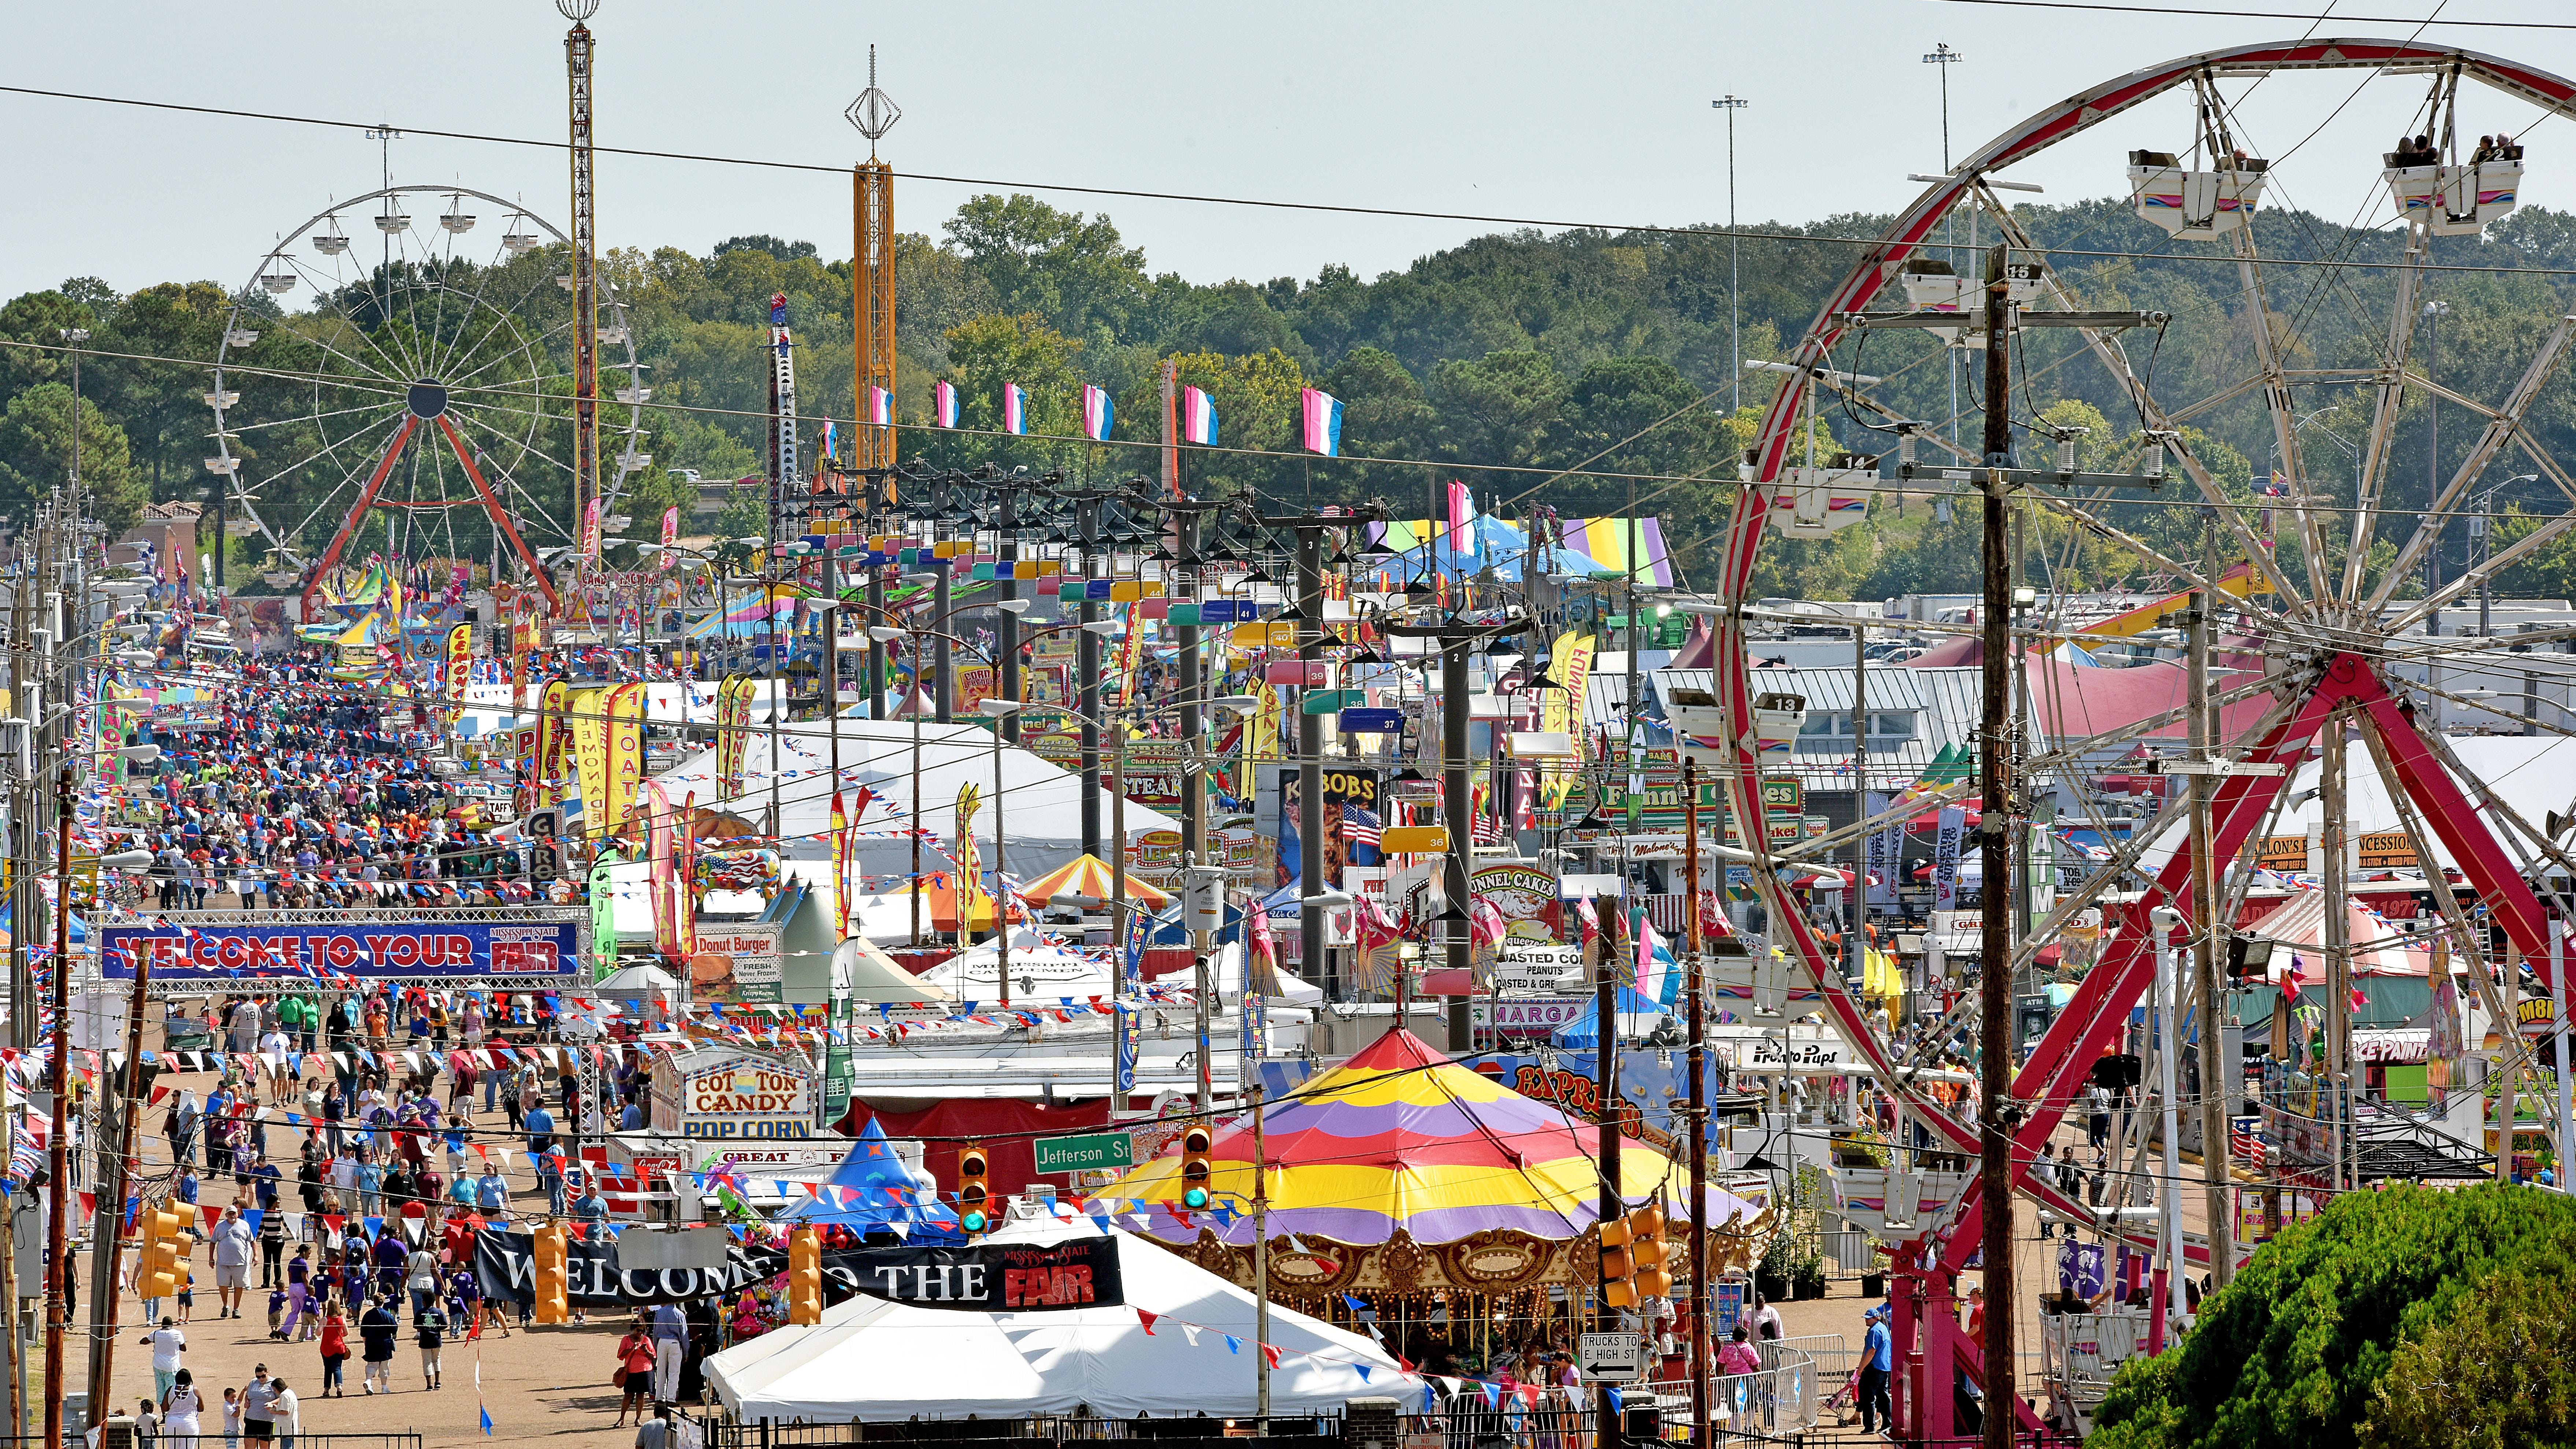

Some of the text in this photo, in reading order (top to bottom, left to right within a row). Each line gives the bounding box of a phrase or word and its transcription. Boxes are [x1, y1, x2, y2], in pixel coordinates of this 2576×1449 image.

[2494, 149, 2504, 161] 2
[2241, 159, 2247, 171] 1
[1845, 456, 1864, 468] 14
[1308, 541, 1313, 549] 3
[1454, 653, 1459, 662] 2
[1776, 699, 1795, 711] 13
[1024, 718, 1045, 728] nnel
[101, 686, 121, 785] LEMONAD
[1629, 723, 1647, 795] ATM
[1285, 773, 1375, 800] KBOBS
[1607, 784, 1702, 807] Fnnl
[489, 803, 512, 812] TAFFY
[1572, 829, 1598, 838] Candy
[1770, 826, 1796, 837] akes
[1231, 845, 1253, 859] COR
[2031, 828, 2053, 914] ATM
[1471, 872, 1556, 898] UNNEL CAKES
[2381, 900, 2420, 917] 1977
[532, 926, 559, 941] STATE
[116, 934, 474, 970] WELCOME TO YOUR
[700, 937, 770, 954] Donut Burger
[490, 941, 559, 973] FAIR
[1500, 953, 1553, 964] OASTED
[1527, 966, 1563, 975] PEANUTS
[1531, 979, 1537, 988] &
[831, 963, 851, 1047] ATM
[246, 1011, 255, 1020] 19
[274, 1040, 281, 1049] 4
[2353, 1041, 2379, 1061] ACE
[1753, 1044, 1837, 1066] Pronto Pups
[696, 1093, 798, 1112] CANDY
[684, 1120, 811, 1138] POP CORN
[723, 1152, 789, 1162] GREAT
[1039, 1141, 1129, 1165] Jefferson St
[875, 1264, 989, 1301] THE
[1005, 1264, 1096, 1308] FAIR
[1584, 1337, 1637, 1347] TRUCKS TO
[1585, 1349, 1635, 1360] E. HIGH ST
